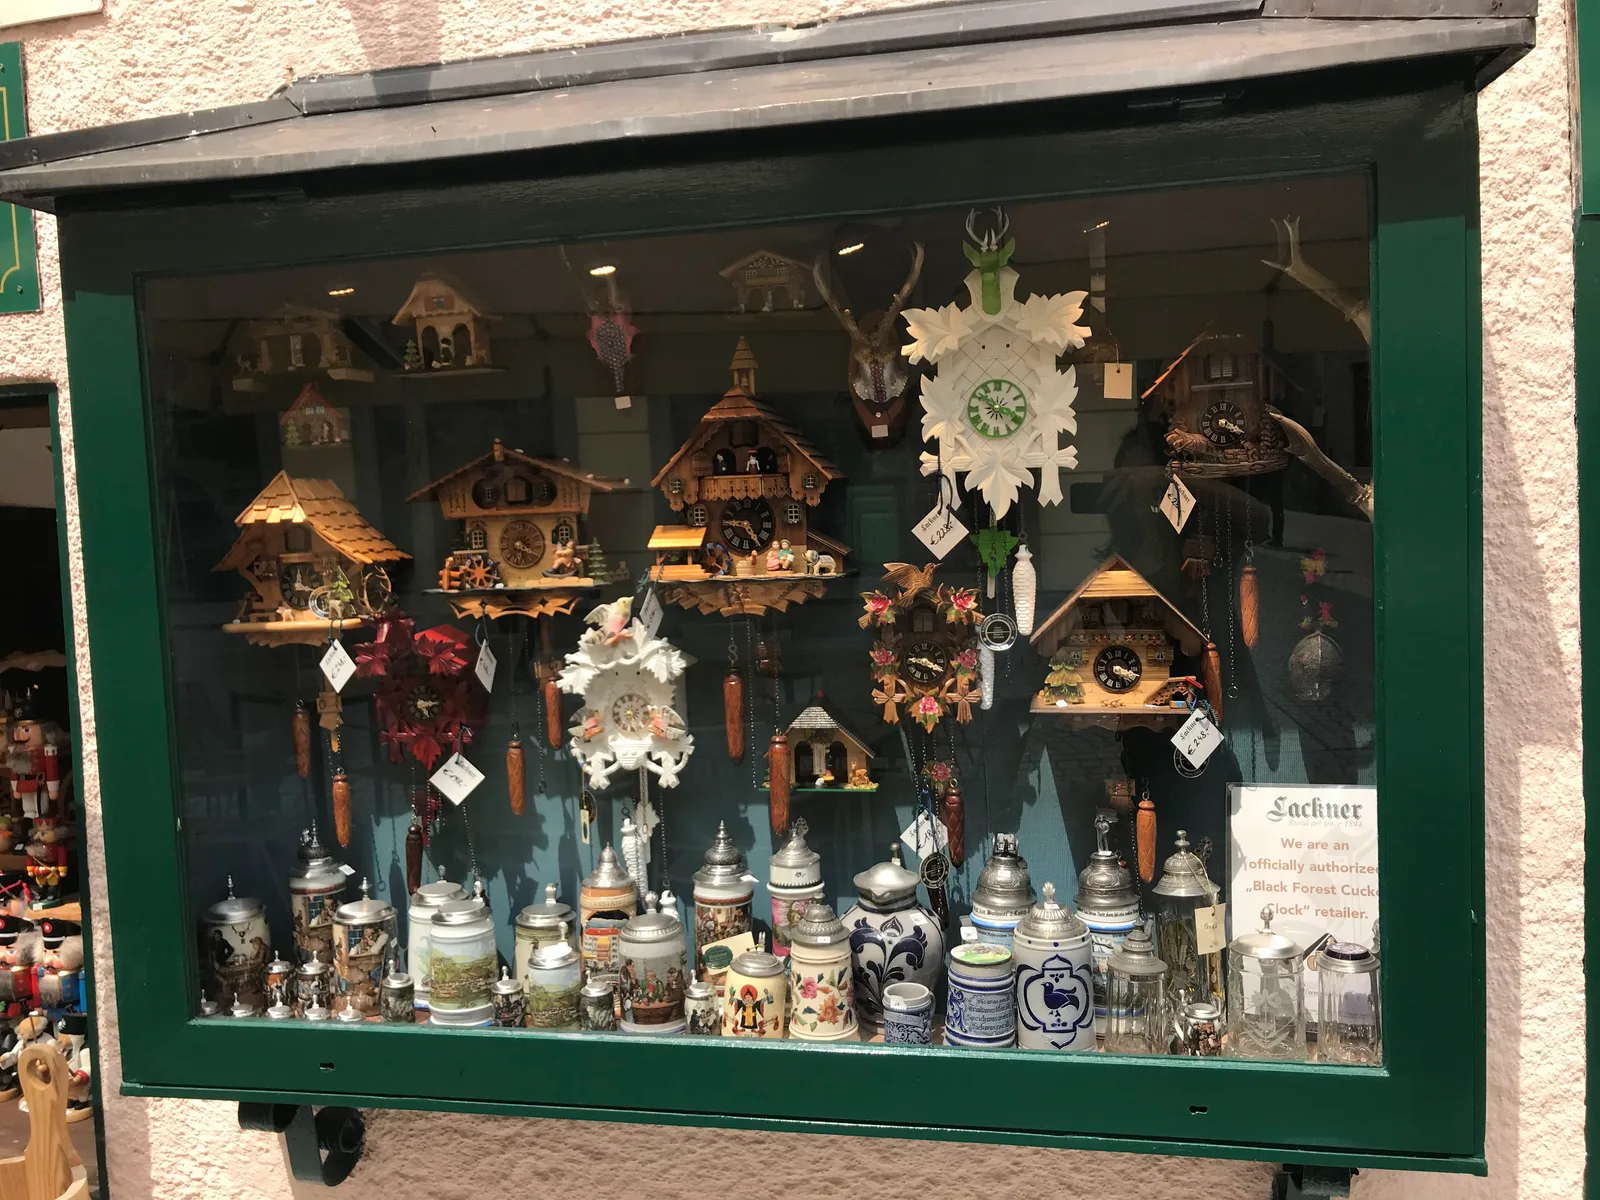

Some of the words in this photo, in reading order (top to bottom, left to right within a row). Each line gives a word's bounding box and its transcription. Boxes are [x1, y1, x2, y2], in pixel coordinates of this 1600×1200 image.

[921, 513, 941, 533] Lackne
[1180, 721, 1197, 741] Lackne
[1266, 795, 1364, 823] Lackner
[1280, 837, 1303, 849] We
[1307, 841, 1329, 850] are
[1333, 842, 1350, 851] an
[1248, 858, 1305, 874] officially
[1292, 882, 1337, 896] Forest
[1315, 905, 1369, 920] retailer.
